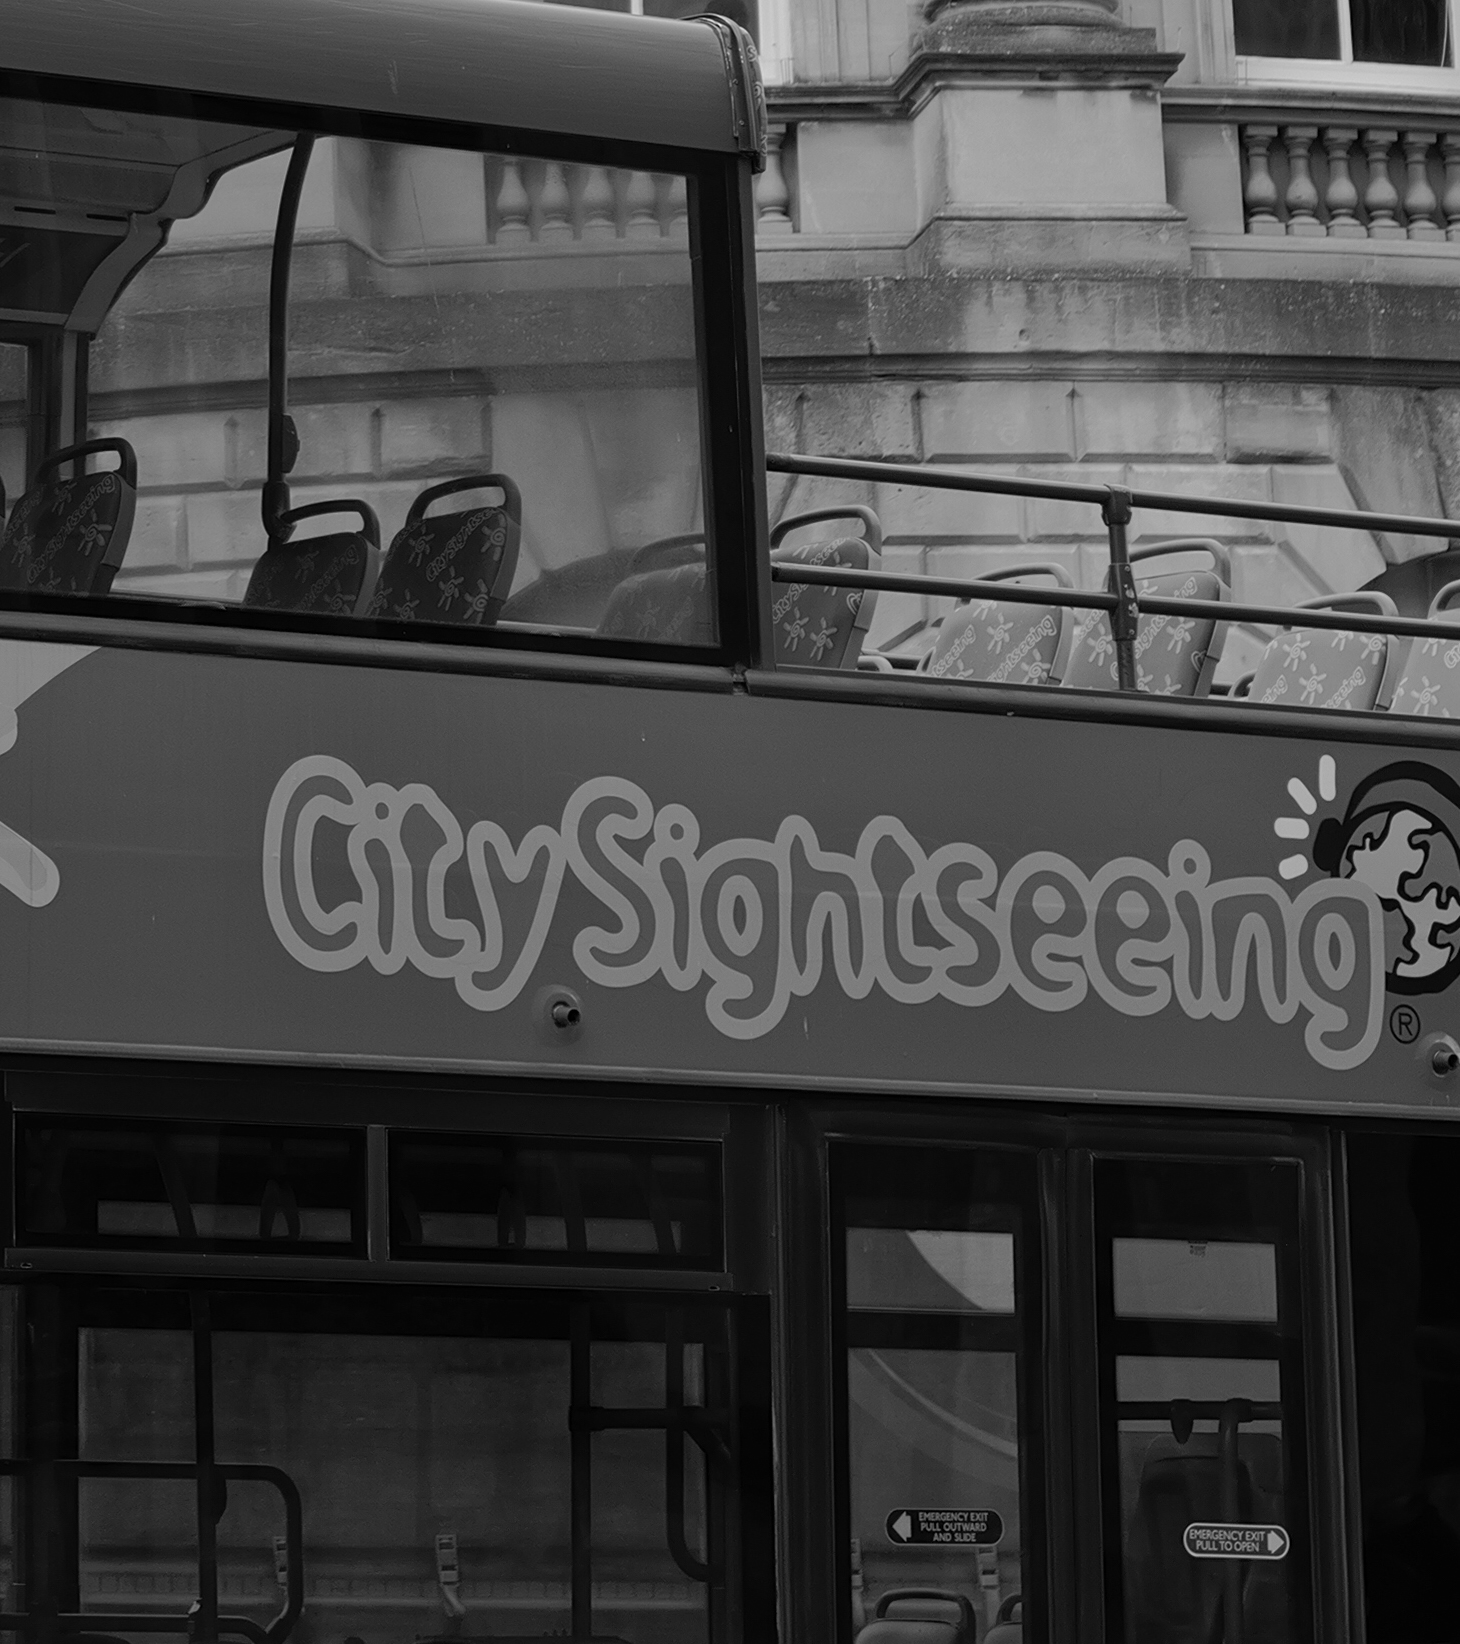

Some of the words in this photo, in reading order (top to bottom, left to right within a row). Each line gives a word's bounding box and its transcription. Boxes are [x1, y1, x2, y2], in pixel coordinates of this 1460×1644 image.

[263, 754, 1386, 1072] CitySightseeing
[918, 1512, 969, 1522] EMERGENCY
[970, 1513, 989, 1523] EXIT
[921, 1522, 941, 1532] PULL
[942, 1522, 987, 1533] OUTWARD
[933, 1532, 952, 1542] AND
[953, 1532, 977, 1542] SLIDE
[1189, 1529, 1244, 1541] EMERGENCY
[1245, 1530, 1265, 1542] EXIT
[1196, 1540, 1217, 1551] PULL
[1218, 1541, 1231, 1551] TO
[1233, 1542, 1260, 1552] OPEN
